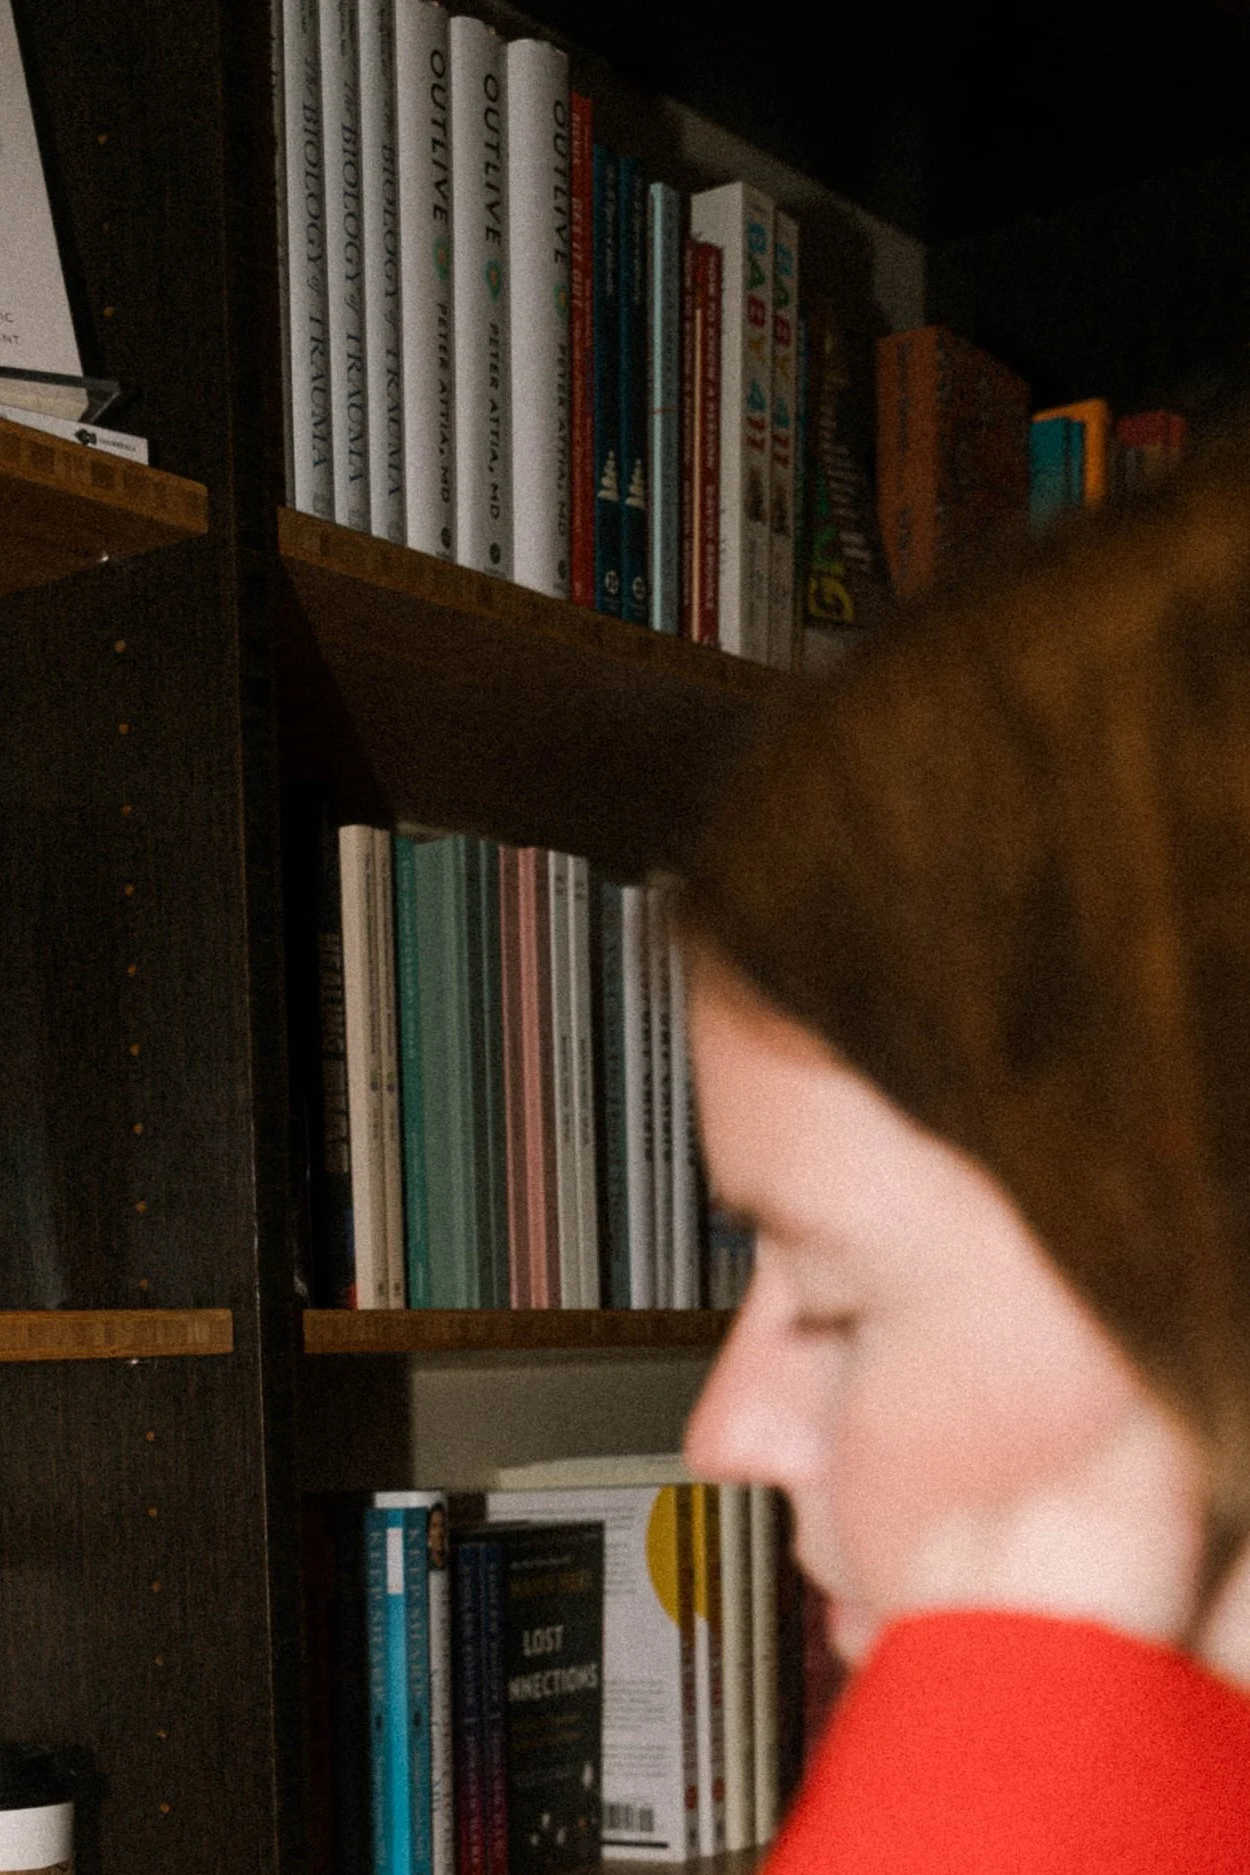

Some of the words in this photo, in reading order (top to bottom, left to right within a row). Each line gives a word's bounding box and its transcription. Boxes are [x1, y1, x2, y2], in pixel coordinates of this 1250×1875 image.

[303, 103, 323, 265] BIOLOGY
[342, 125, 359, 282] BIOLOGY
[430, 50, 448, 225] OUTLIVE
[483, 73, 500, 245] OUTLIVE
[554, 98, 568, 265] OUTLIVE
[381, 144, 398, 297] BIOLOGY
[308, 312, 327, 469] TRAUMA
[346, 330, 363, 481] TRAUMA
[438, 302, 448, 369] PETER
[488, 323, 499, 388] PETER
[385, 345, 402, 497] TRAUMA
[438, 379, 449, 456] ATTIA,
[439, 470, 449, 501] MD
[488, 398, 500, 472] ATTIA,
[490, 483, 500, 519] MD
[523, 1626, 564, 1656] LOST
